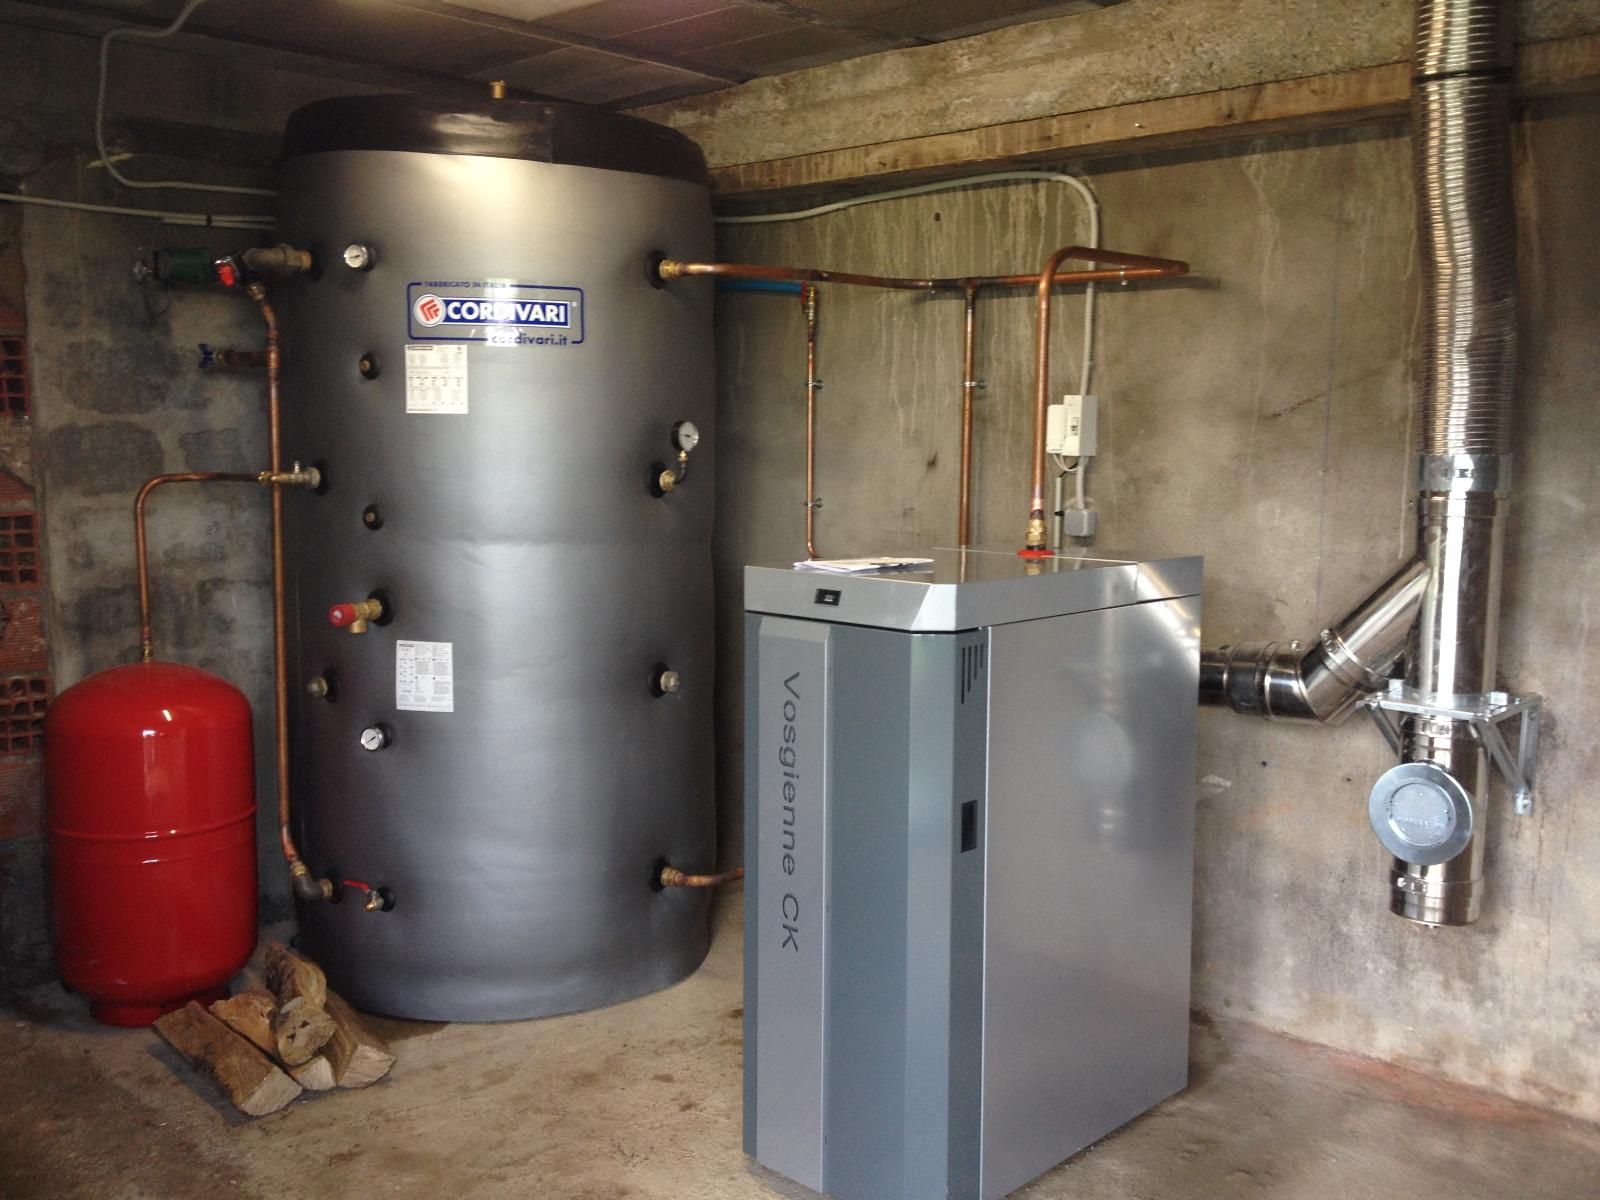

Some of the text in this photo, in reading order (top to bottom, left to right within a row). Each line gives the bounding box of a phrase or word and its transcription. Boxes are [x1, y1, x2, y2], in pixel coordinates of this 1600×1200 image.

[447, 301, 565, 323] CORDIVARI
[491, 331, 568, 346] cordivari.it
[778, 672, 800, 953] Vosgienne CK
